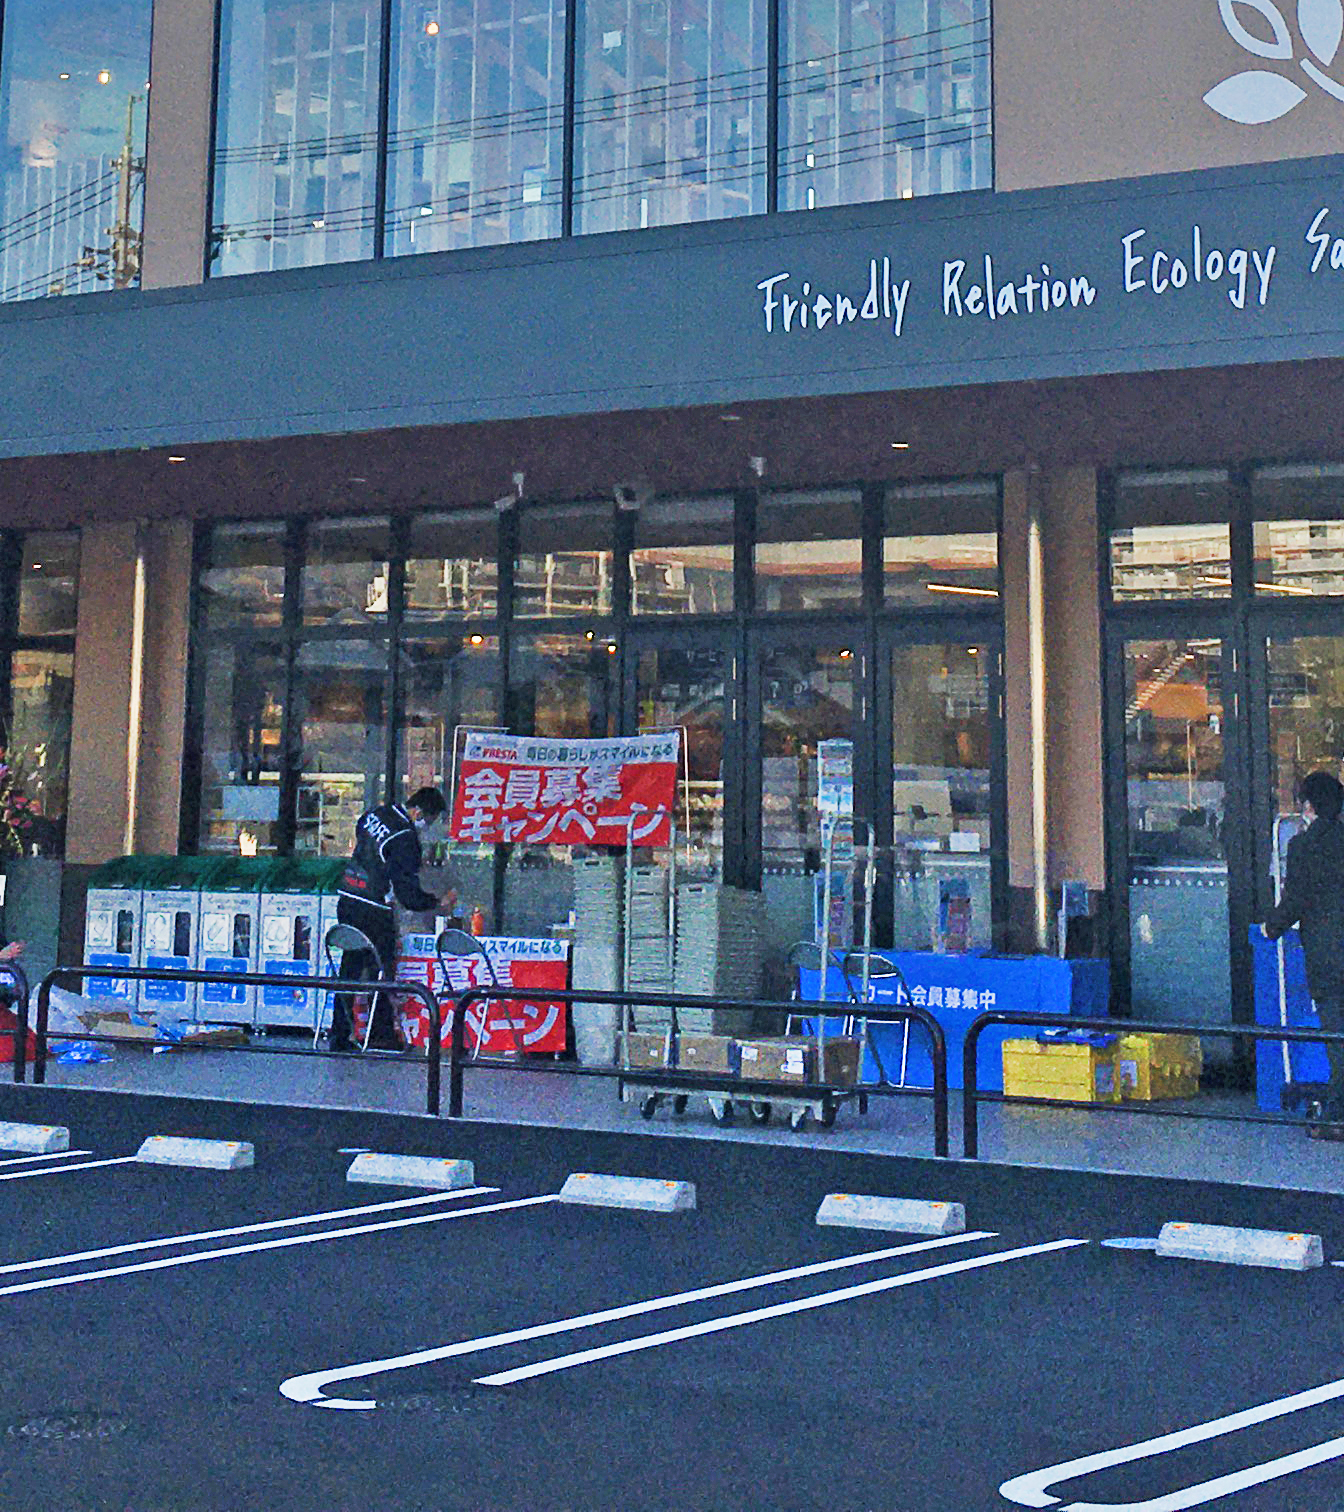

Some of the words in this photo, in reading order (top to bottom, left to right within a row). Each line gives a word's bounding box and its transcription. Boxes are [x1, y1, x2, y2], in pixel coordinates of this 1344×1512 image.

[757, 255, 912, 335] Friendly
[942, 254, 1097, 321] Relation
[1122, 227, 1275, 306] Ecology
[482, 747, 519, 760] FRESTA
[464, 763, 624, 810] 会員募集
[363, 812, 391, 842] STAFF
[458, 802, 667, 844] キャンペーン
